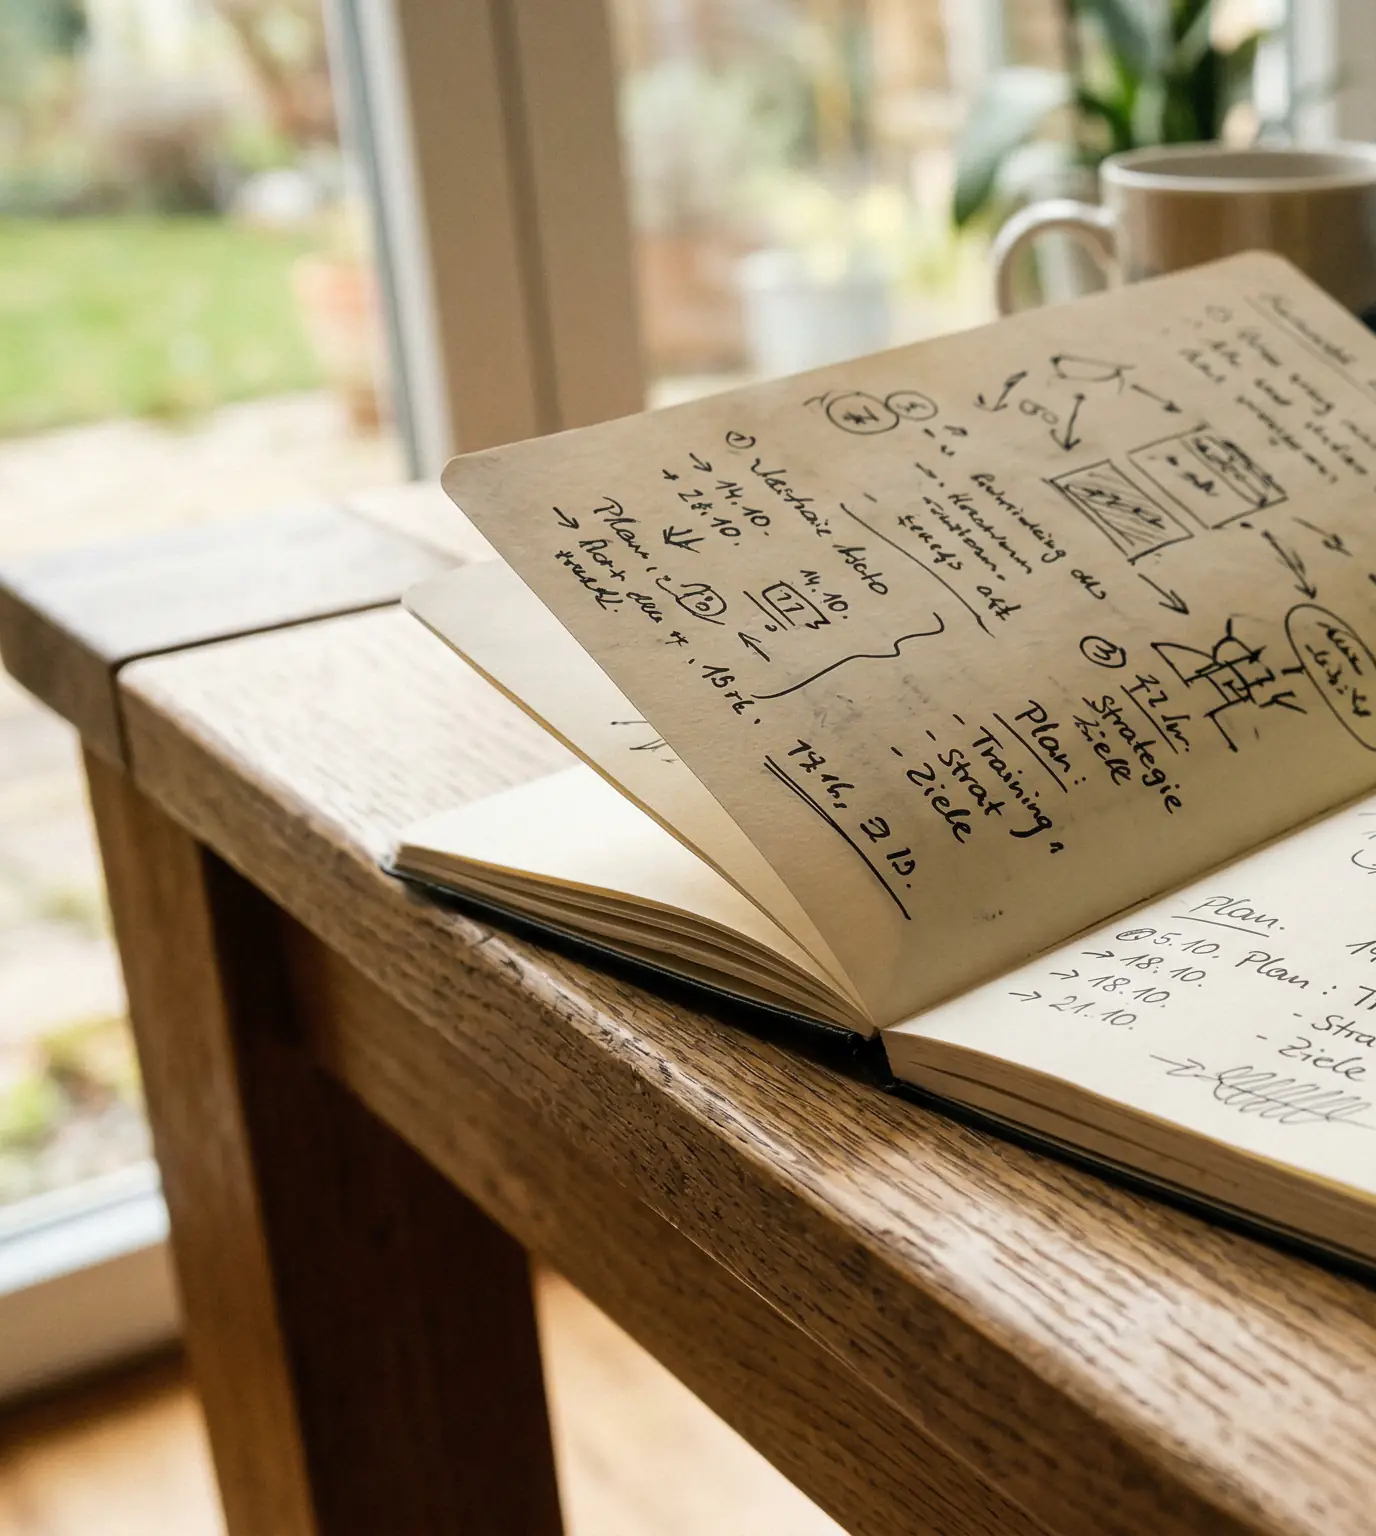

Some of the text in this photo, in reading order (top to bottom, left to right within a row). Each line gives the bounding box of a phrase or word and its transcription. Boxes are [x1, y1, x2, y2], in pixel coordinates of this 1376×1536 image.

[937, 748, 1006, 818] Strat
[1085, 694, 1183, 815] Strategie
[905, 761, 973, 844] Ziele
[1277, 1035, 1369, 1083] Ziele
